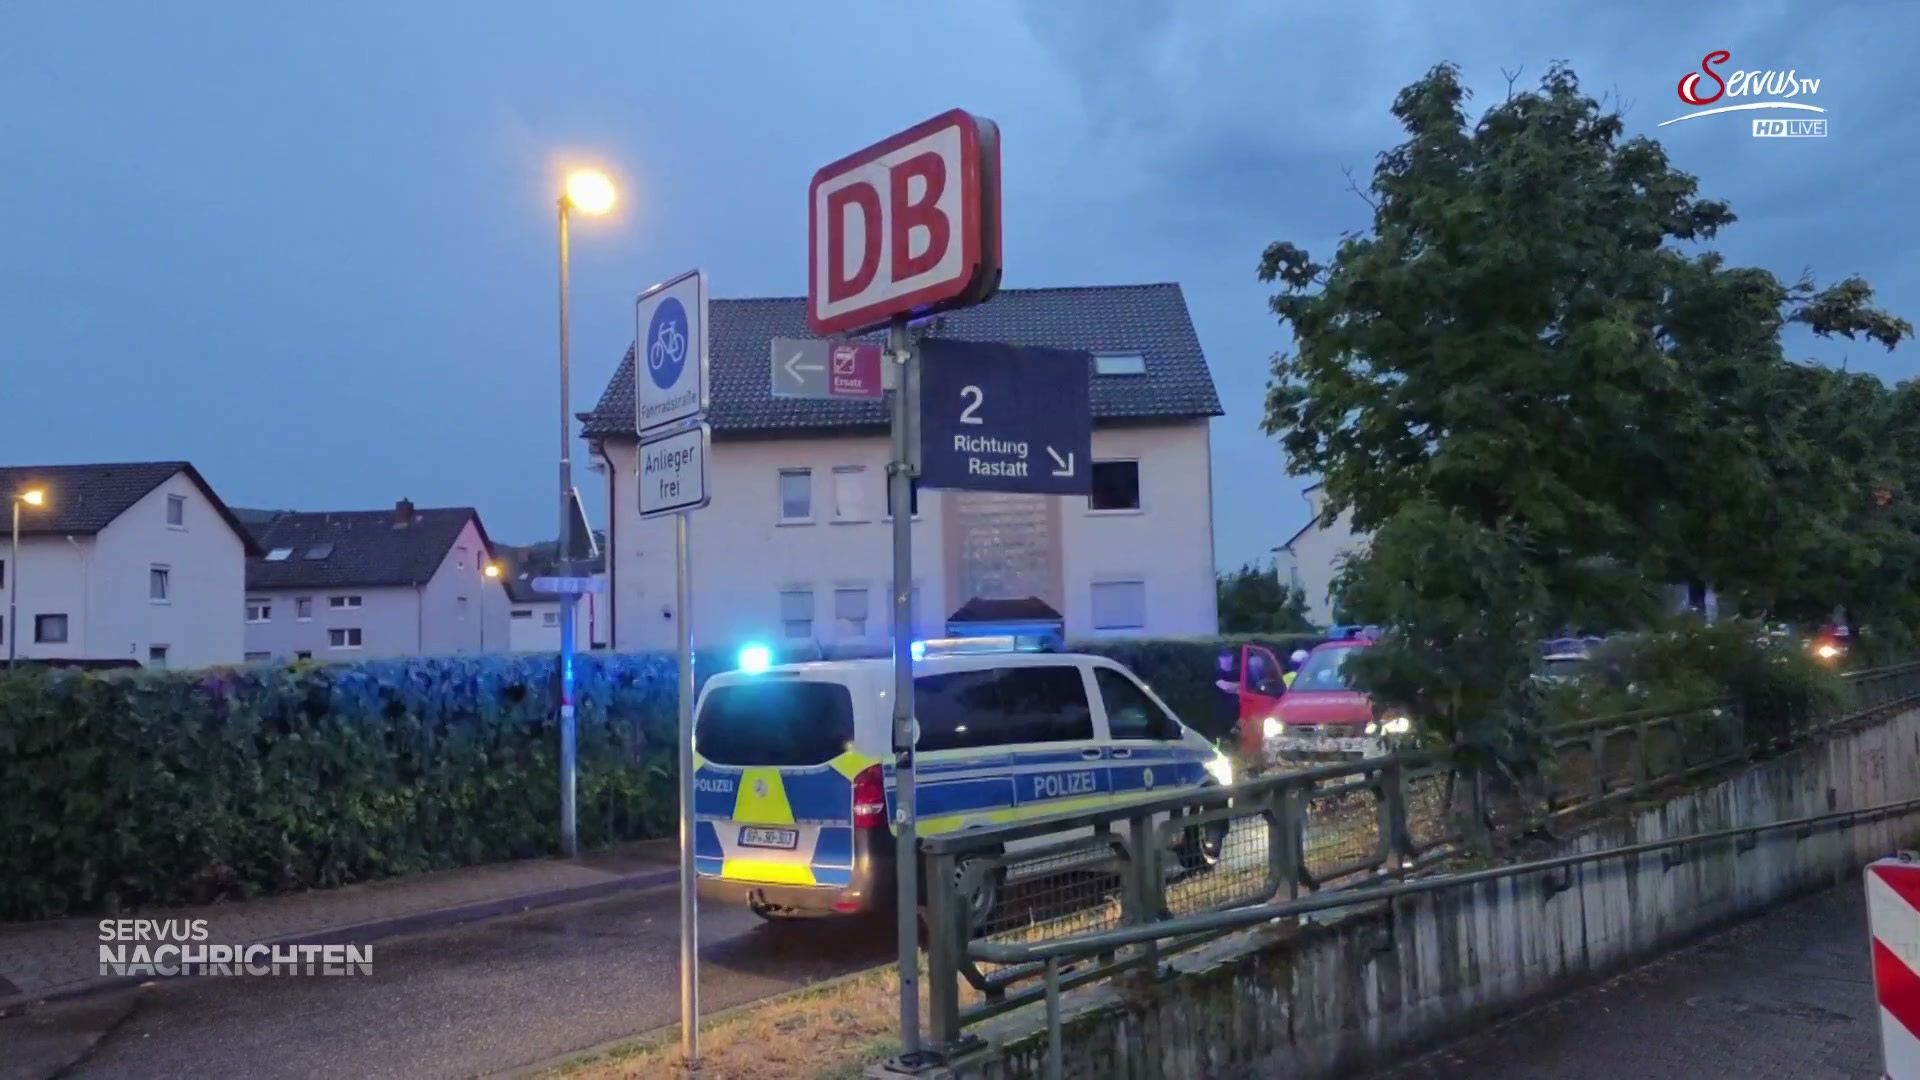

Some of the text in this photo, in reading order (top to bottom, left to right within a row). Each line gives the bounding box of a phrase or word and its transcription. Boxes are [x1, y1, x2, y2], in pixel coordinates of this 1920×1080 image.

[827, 151, 951, 305] DB
[959, 385, 984, 425] 2
[954, 435, 1029, 458] Richtung
[645, 446, 695, 476] Anlieger
[968, 458, 1028, 477] Rastatt
[659, 473, 680, 500] frei
[1034, 771, 1096, 798] POLIZEI
